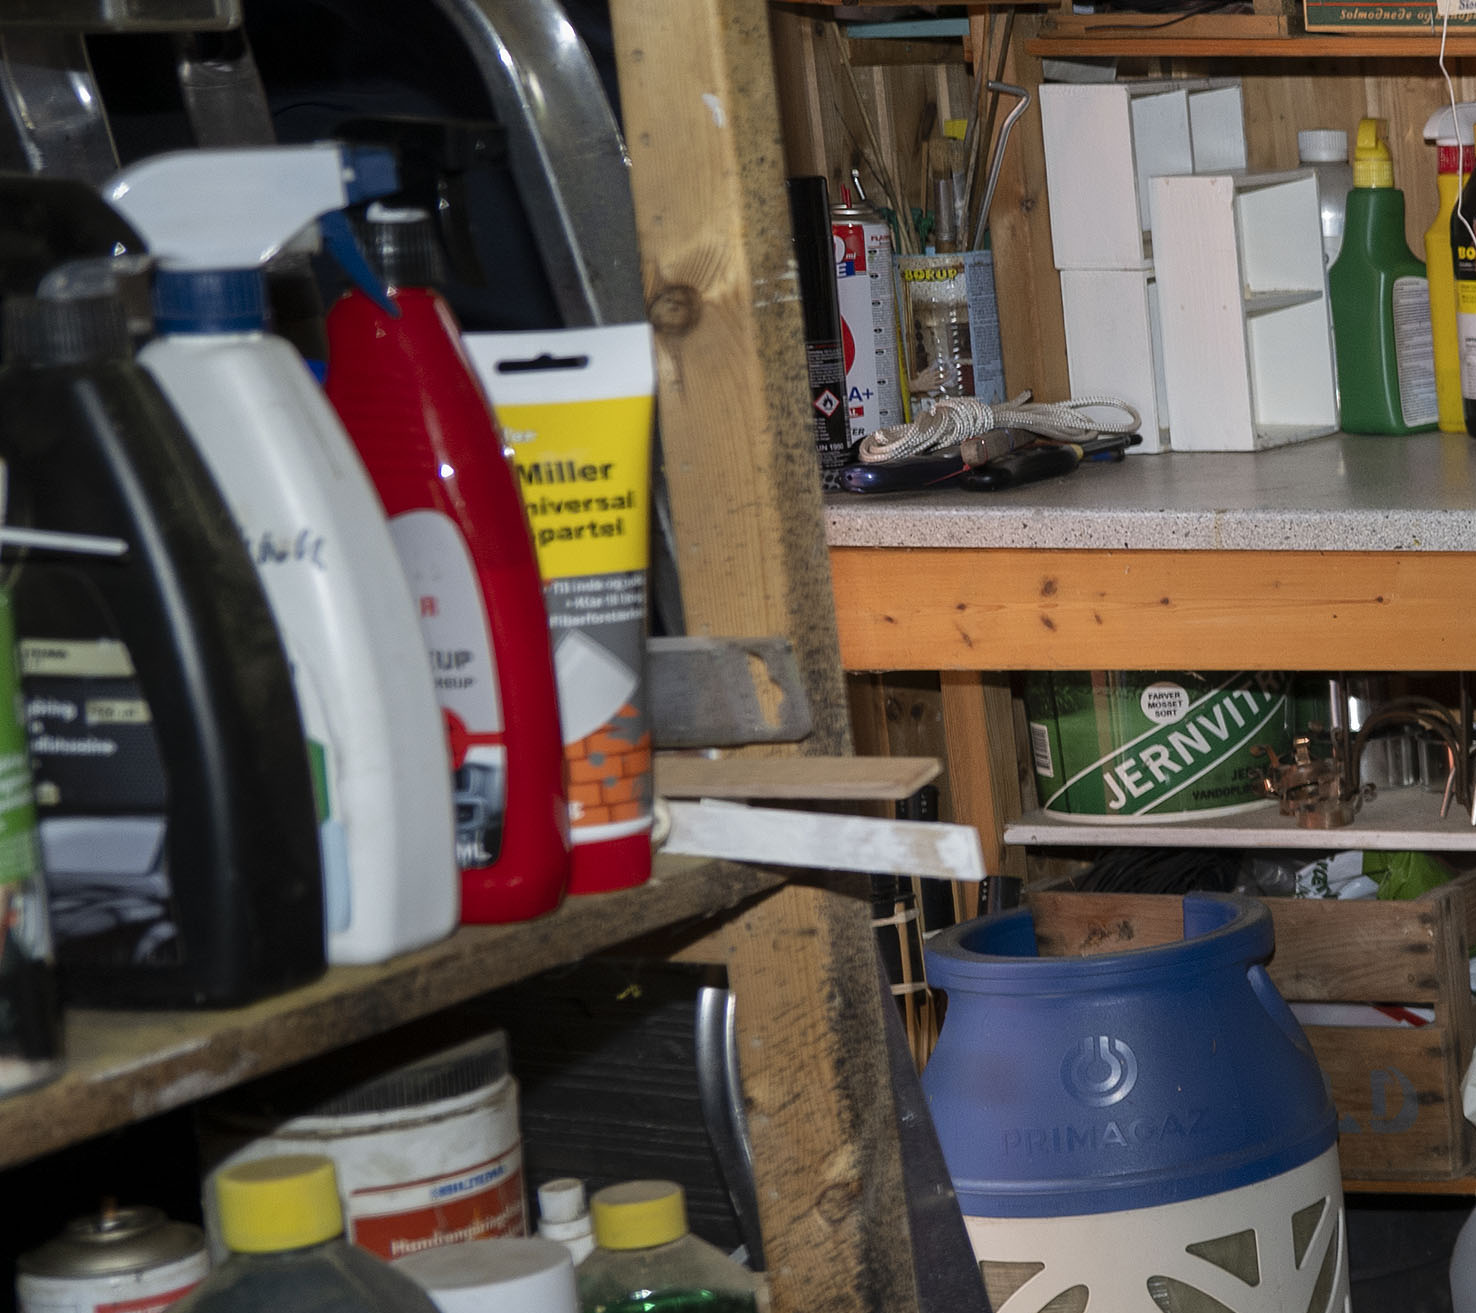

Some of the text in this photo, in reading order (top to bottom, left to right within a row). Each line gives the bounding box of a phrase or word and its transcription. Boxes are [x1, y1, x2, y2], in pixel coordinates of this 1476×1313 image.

[1340, 7, 1412, 21] Solmodnede
[1416, 10, 1432, 23] og
[904, 268, 958, 282] BORUP
[516, 461, 615, 485] Miller
[525, 490, 635, 517] niversal
[537, 518, 625, 547] partel
[1147, 691, 1181, 701] FARVER
[1147, 700, 1184, 710] MOSSET
[1154, 709, 1178, 718] SORT
[1002, 1113, 1203, 1155] PRIMAGAZ
